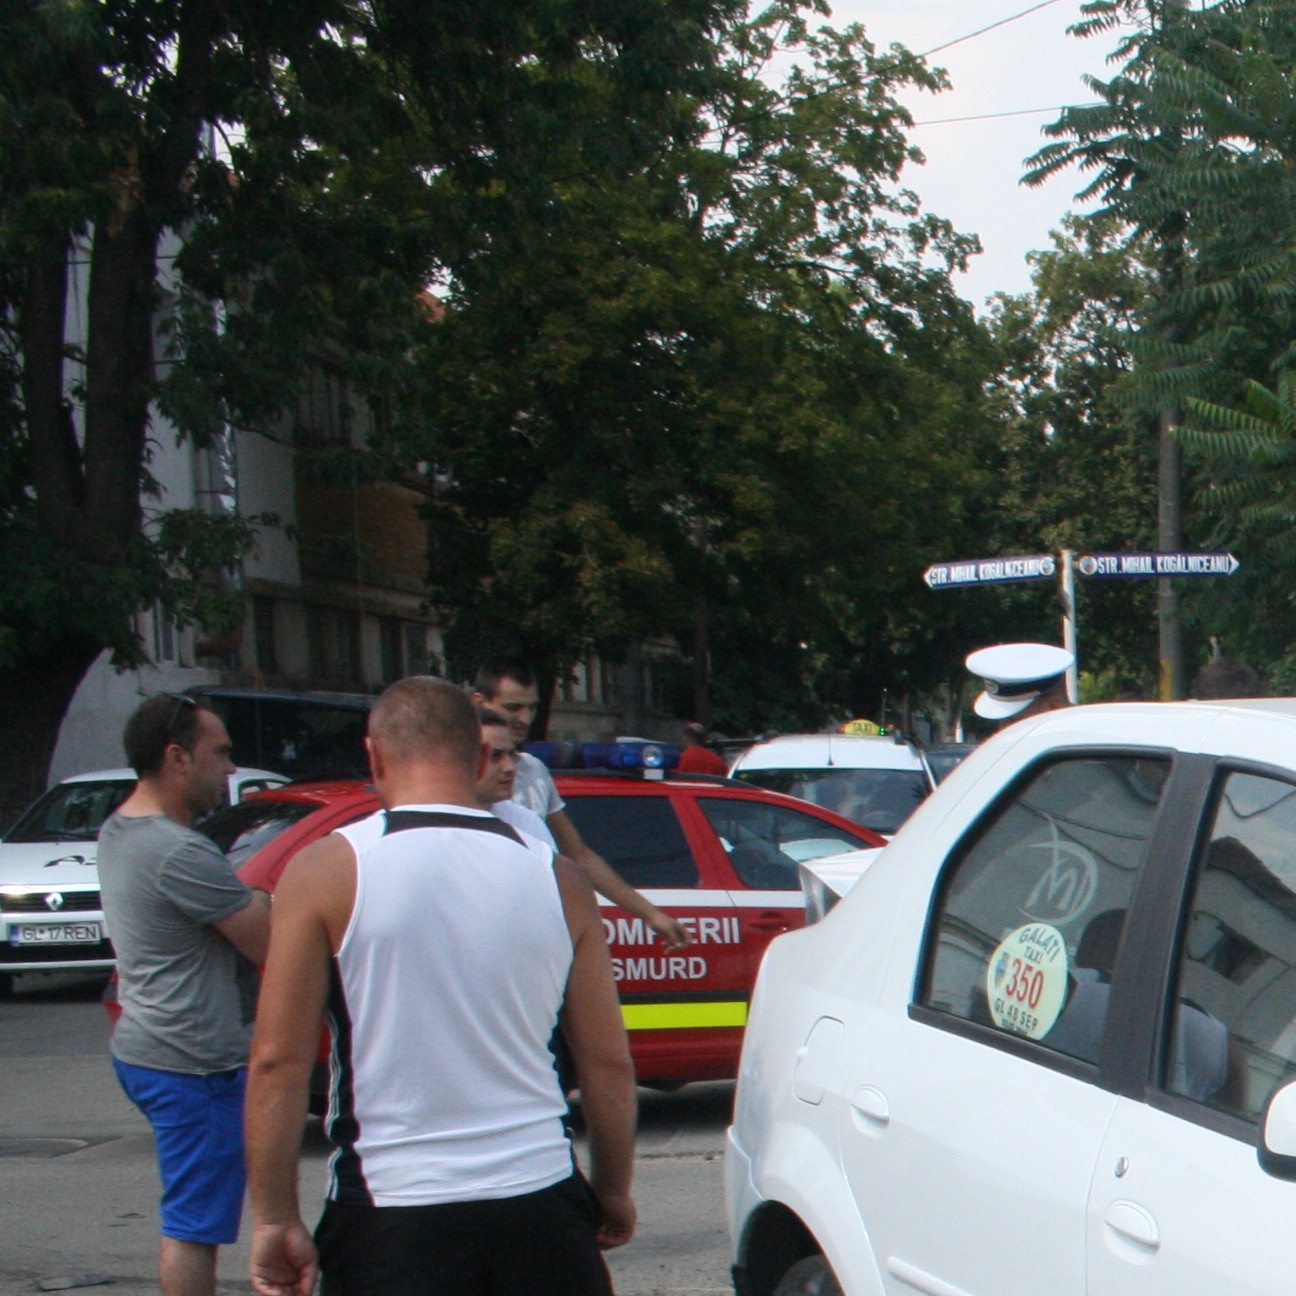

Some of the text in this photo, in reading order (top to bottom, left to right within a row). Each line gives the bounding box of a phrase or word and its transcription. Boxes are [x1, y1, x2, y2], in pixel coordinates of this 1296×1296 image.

[852, 722, 873, 734] TAXI
[1024, 945, 1044, 965] TAXI
[611, 957, 707, 981] SMURD
[1006, 958, 1044, 1009] 350
